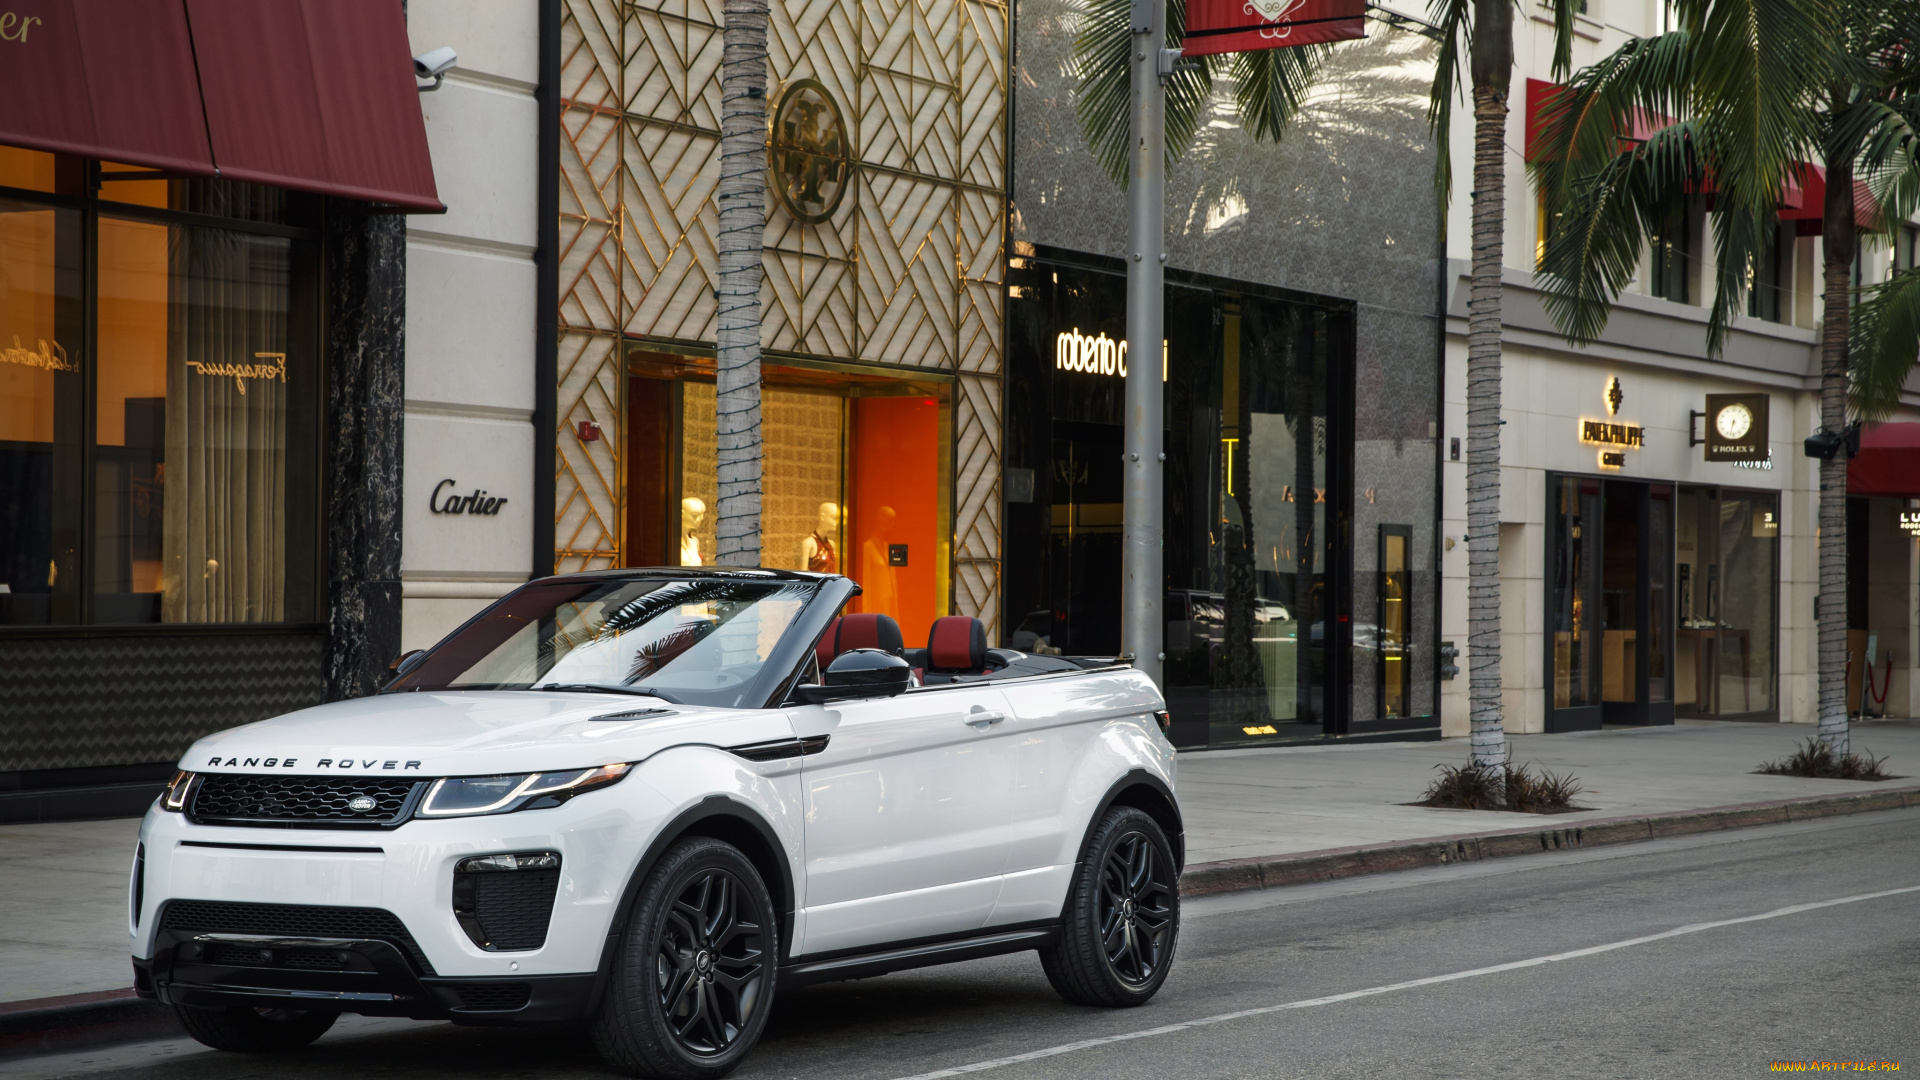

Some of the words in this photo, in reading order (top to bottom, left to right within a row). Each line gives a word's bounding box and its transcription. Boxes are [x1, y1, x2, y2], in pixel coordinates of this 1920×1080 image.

[1057, 327, 1117, 376] roberto
[1720, 445, 1748, 453] ROLEX
[430, 478, 508, 516] Cartier
[207, 756, 298, 768] RANGE
[316, 758, 422, 770] ROVER
